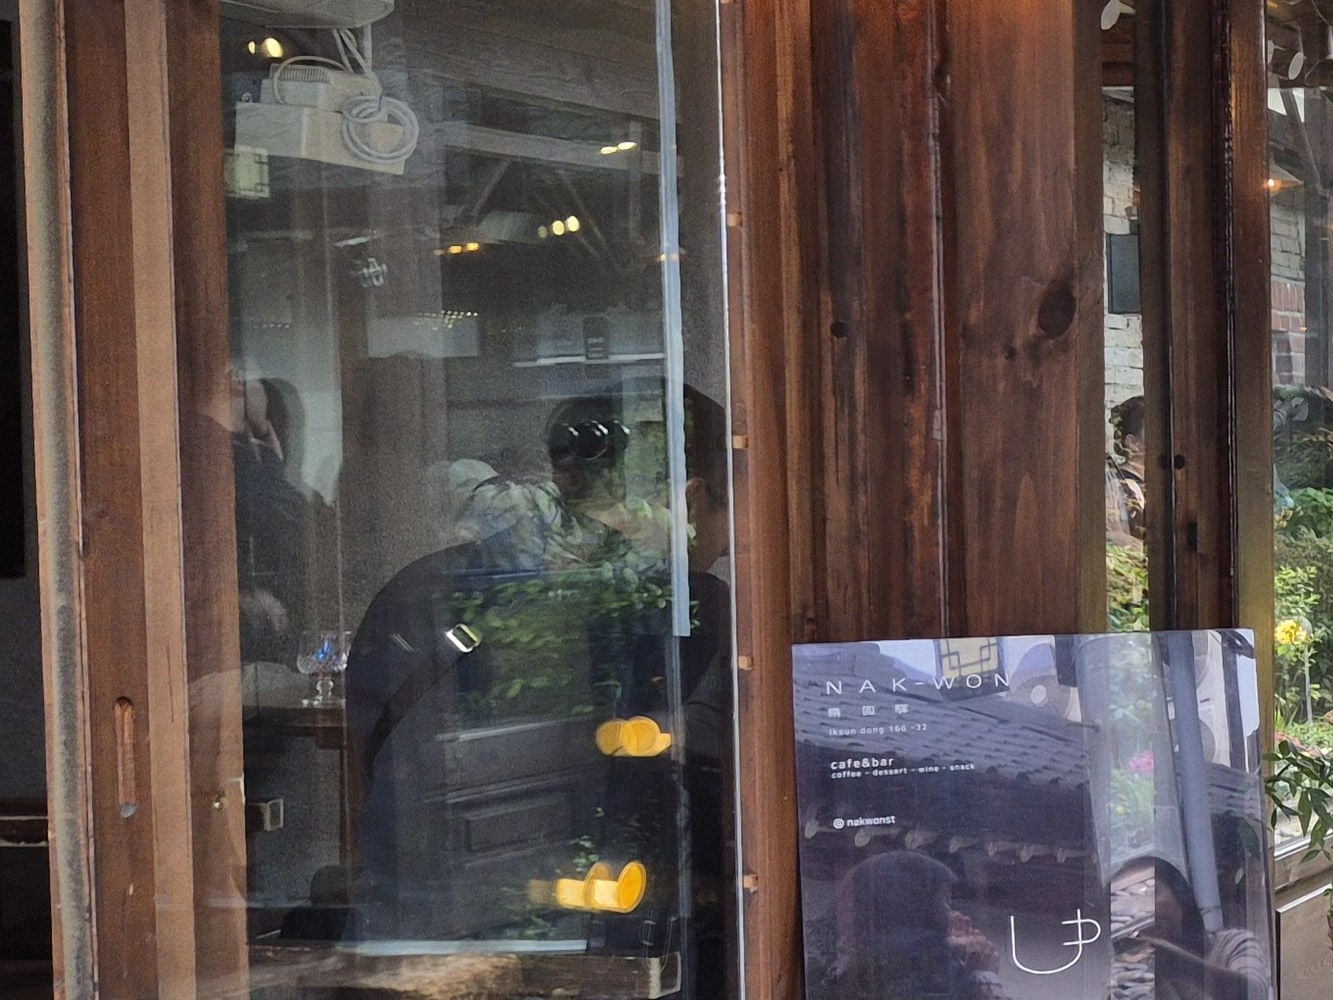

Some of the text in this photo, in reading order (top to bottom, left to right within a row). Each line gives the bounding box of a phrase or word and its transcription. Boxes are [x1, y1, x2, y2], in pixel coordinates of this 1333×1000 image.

[860, 726, 884, 735] dong
[830, 757, 894, 770] cafe&bar
[831, 770, 862, 779] coffee
[872, 768, 907, 777] dessert
[950, 763, 975, 772] snack
